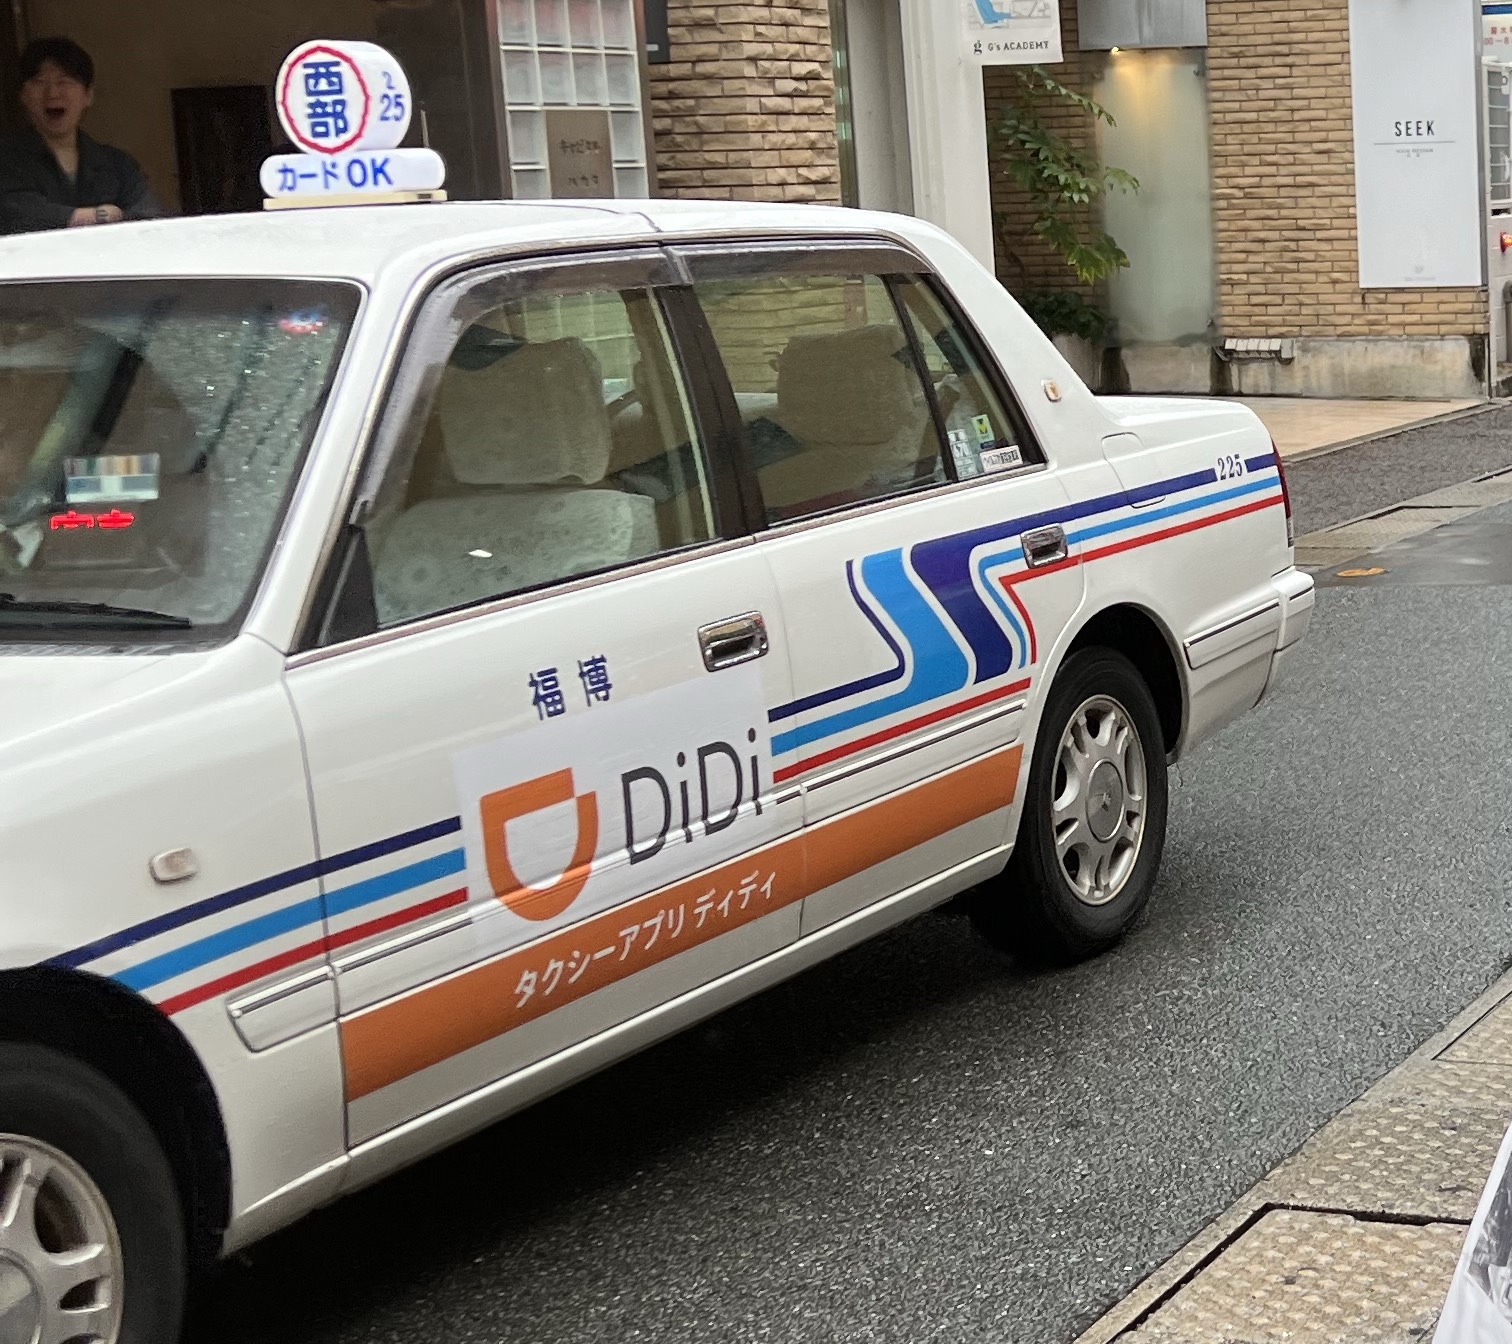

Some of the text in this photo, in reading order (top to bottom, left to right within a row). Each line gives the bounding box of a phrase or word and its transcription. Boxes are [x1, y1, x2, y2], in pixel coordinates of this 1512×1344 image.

[1004, 40, 1049, 51] ACADEMY
[302, 60, 348, 138] 西部
[379, 94, 405, 122] 25
[1394, 120, 1435, 137] SEEK
[1217, 453, 1243, 481] 225
[620, 727, 763, 866] DiDi
